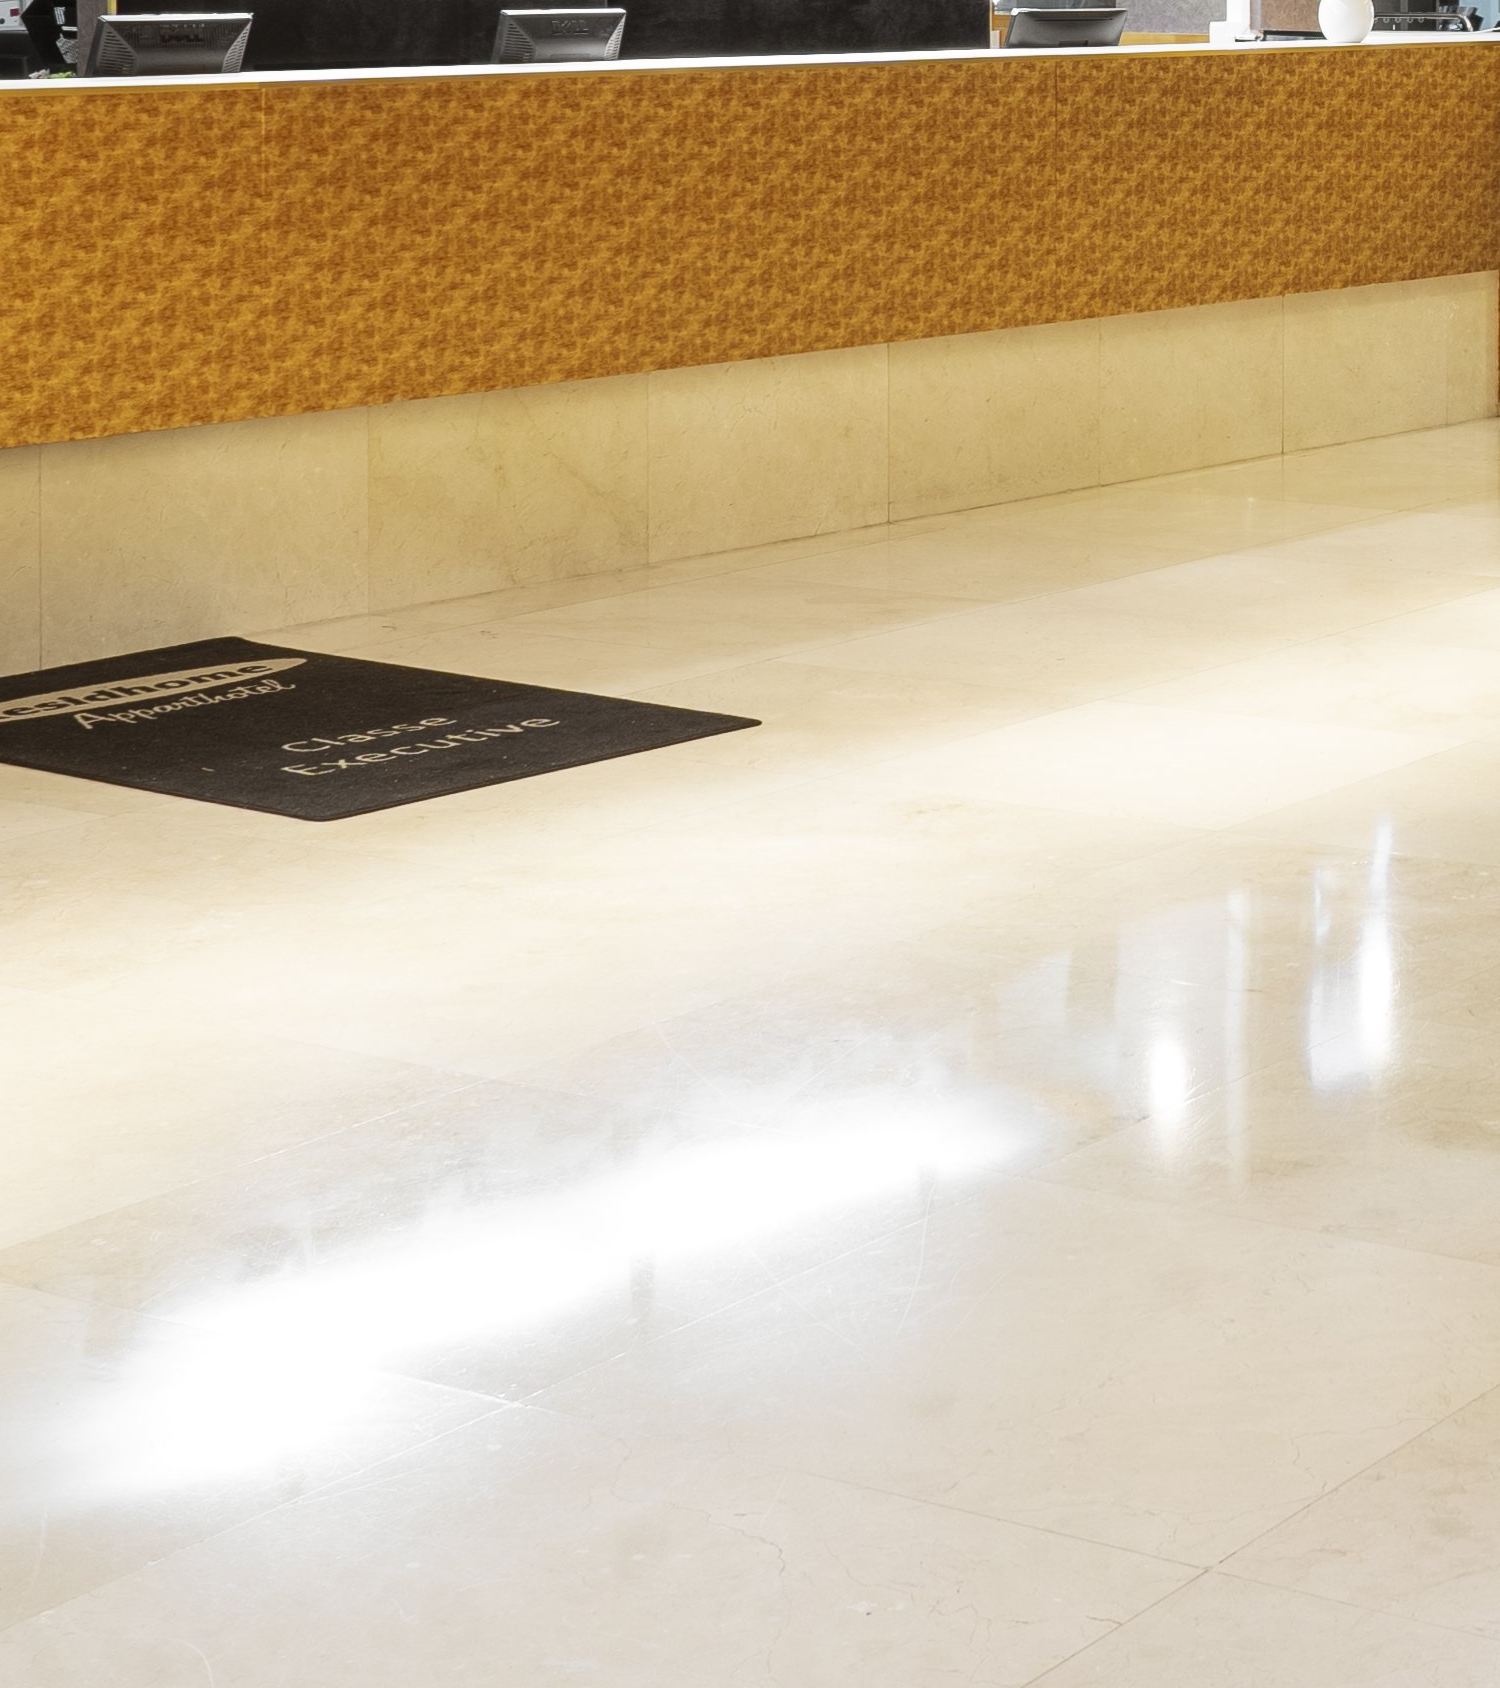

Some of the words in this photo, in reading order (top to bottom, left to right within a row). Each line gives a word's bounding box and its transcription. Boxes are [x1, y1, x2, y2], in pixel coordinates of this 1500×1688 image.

[71, 679, 297, 729] Apparthotel
[280, 716, 561, 776] Executive
[281, 716, 457, 752] Classe
